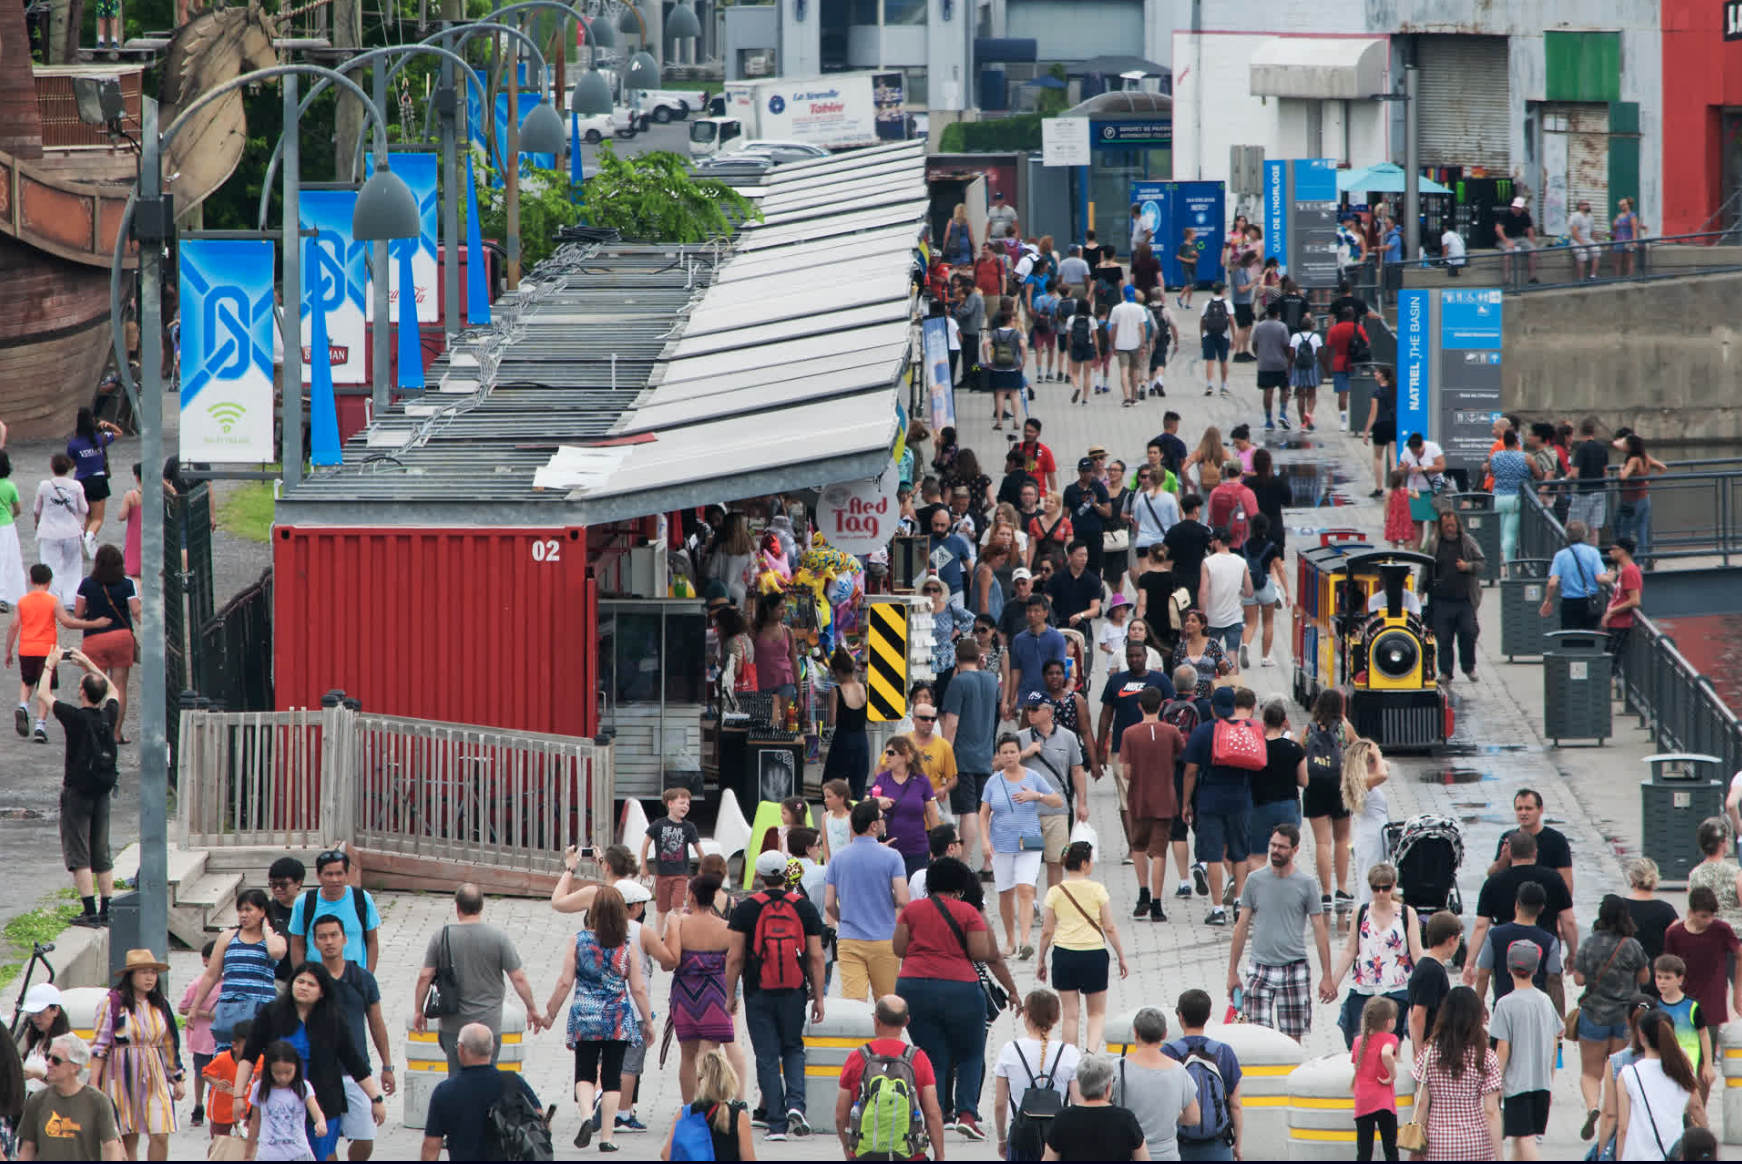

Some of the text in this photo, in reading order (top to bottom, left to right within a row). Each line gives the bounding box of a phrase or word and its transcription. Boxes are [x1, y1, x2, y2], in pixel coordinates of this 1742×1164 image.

[1272, 217, 1281, 230] DE
[1410, 296, 1420, 333] BASIN
[1409, 334, 1420, 359] THE
[848, 496, 888, 515] Red
[830, 508, 880, 539] Tag
[531, 539, 560, 562] 02
[1123, 681, 1147, 691] NIKE
[662, 826, 683, 835] BEAR
